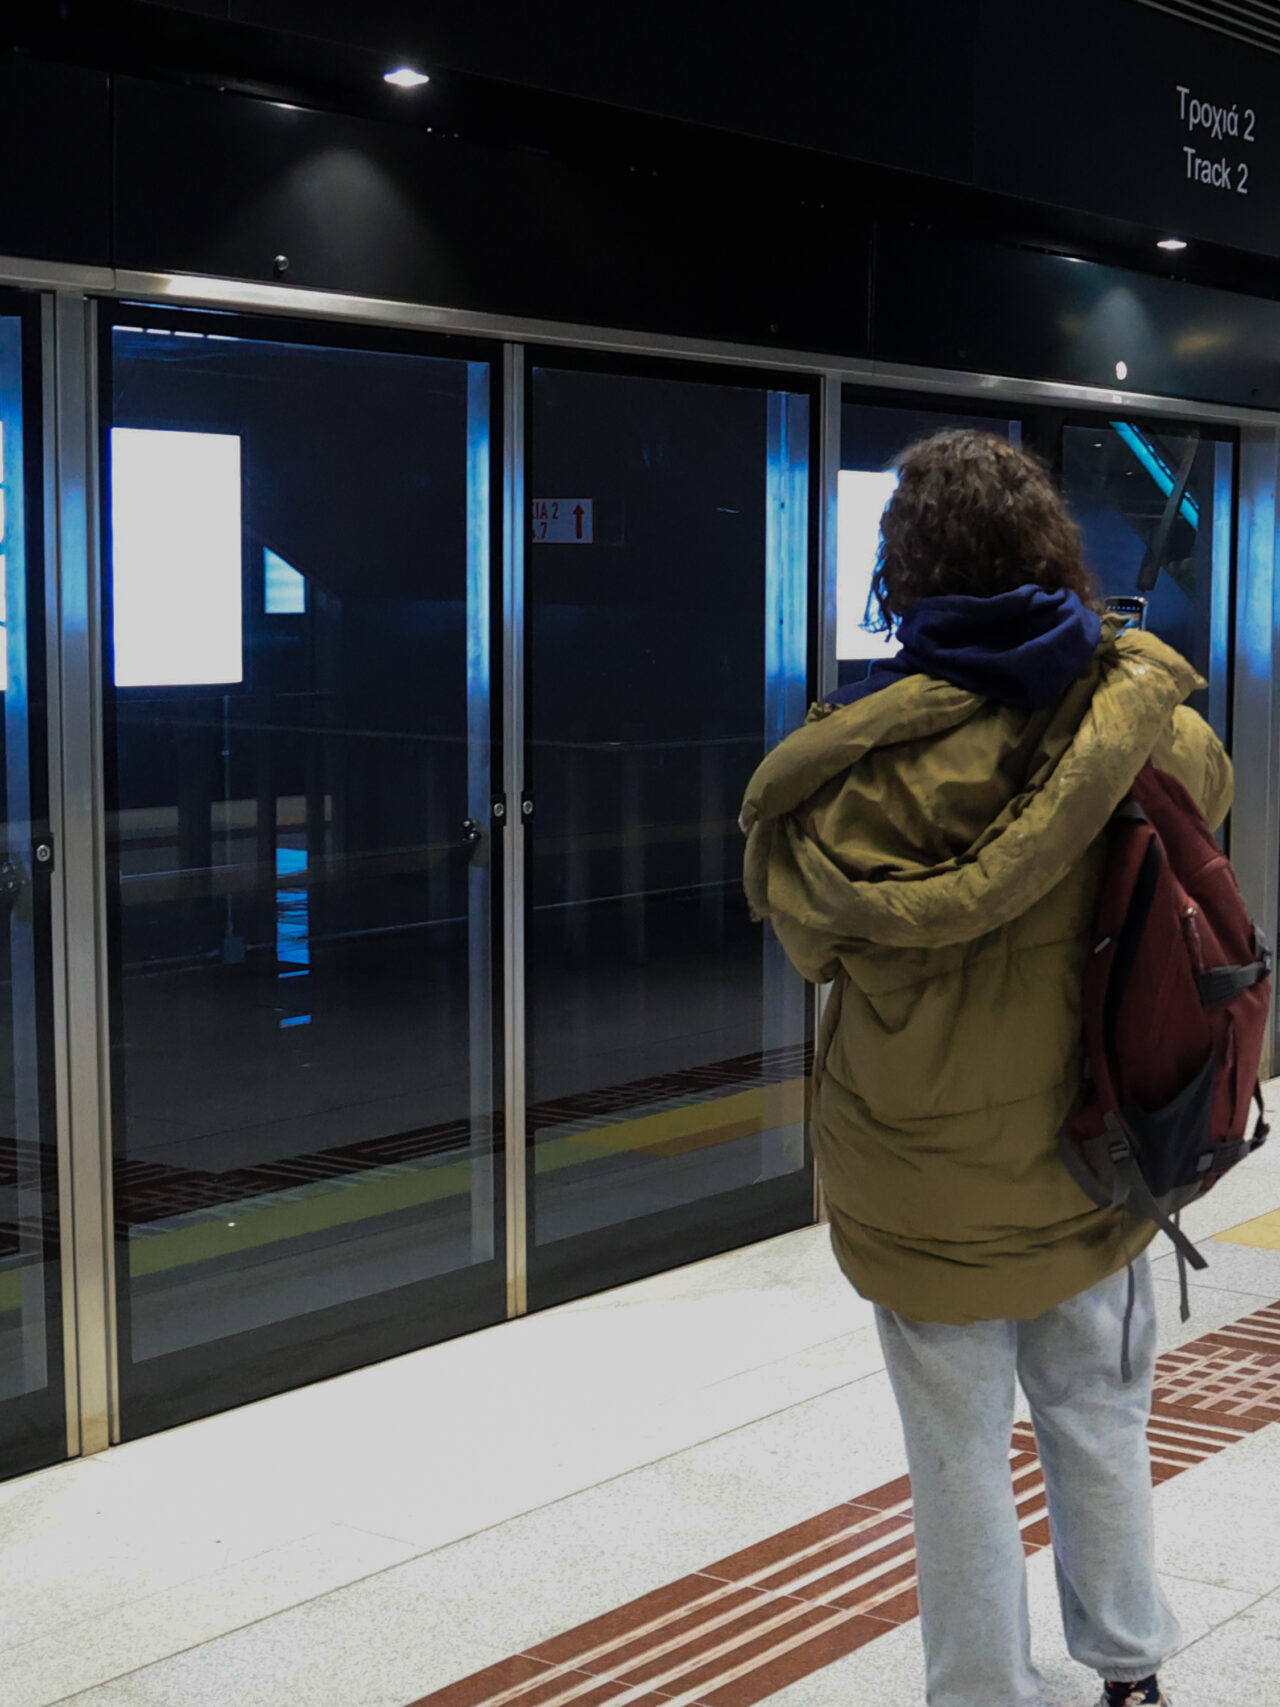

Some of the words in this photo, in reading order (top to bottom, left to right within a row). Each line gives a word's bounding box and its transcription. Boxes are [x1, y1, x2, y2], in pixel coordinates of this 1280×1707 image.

[1176, 85, 1239, 140] Τροχιά
[1243, 109, 1255, 142] 2
[1183, 146, 1231, 190] Track
[1237, 163, 1248, 194] 2
[552, 502, 559, 520] 2
